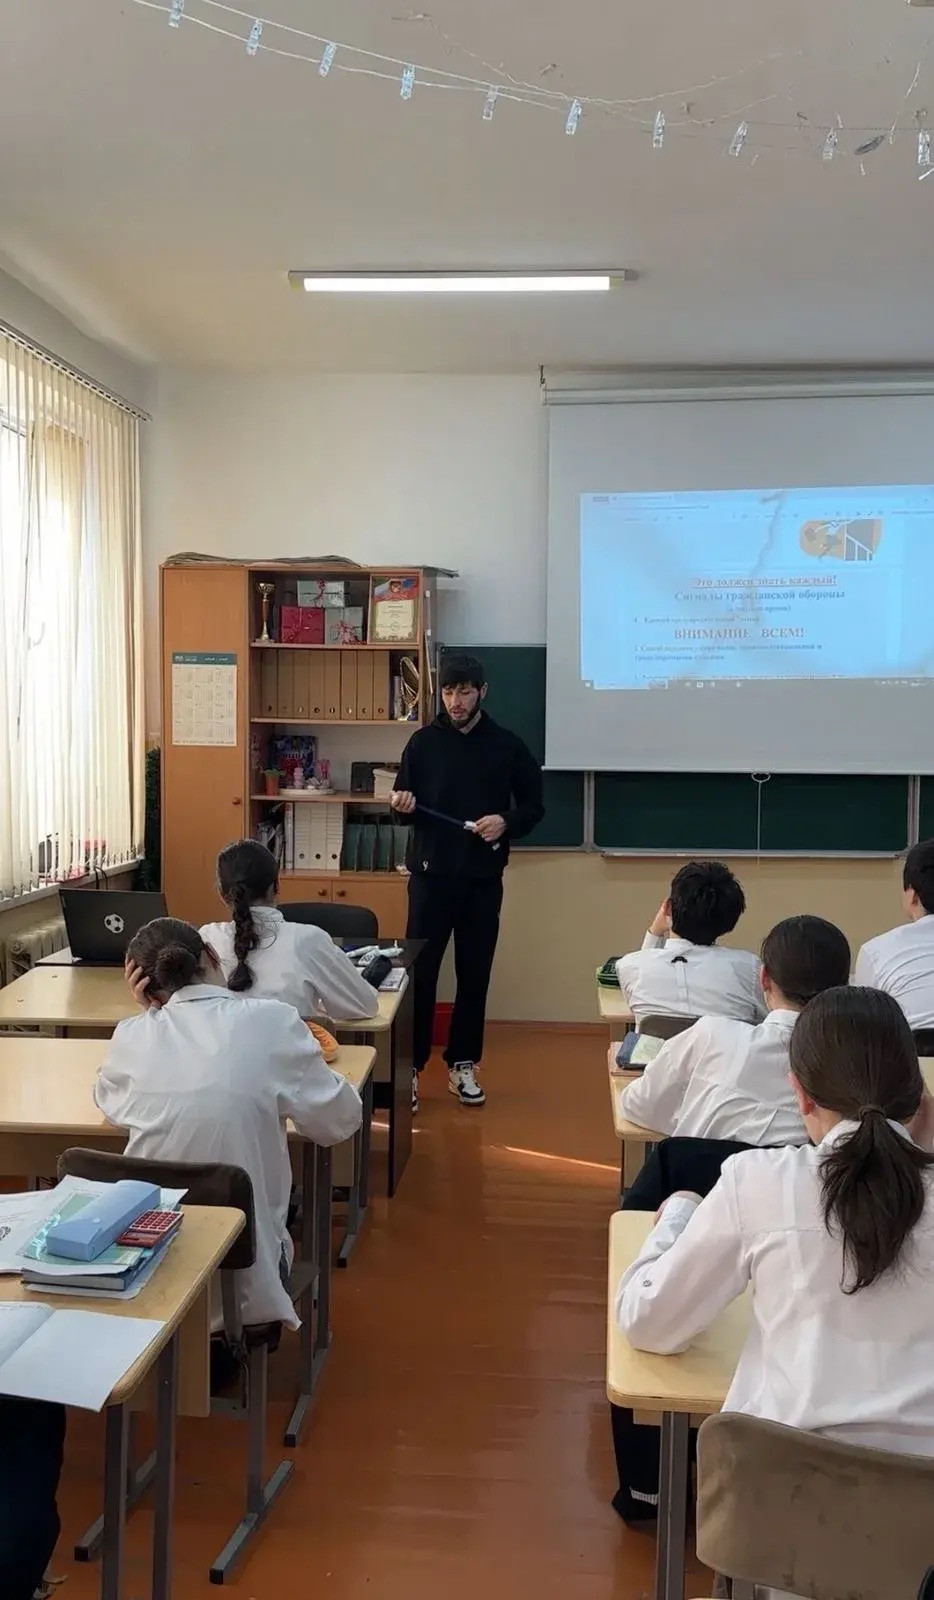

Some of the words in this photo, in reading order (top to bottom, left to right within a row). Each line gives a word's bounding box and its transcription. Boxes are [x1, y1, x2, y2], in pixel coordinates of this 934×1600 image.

[798, 589, 846, 602] обороны
[674, 628, 752, 639] ВНИМАНИЕ
[761, 626, 805, 639] ВСЕМ!
